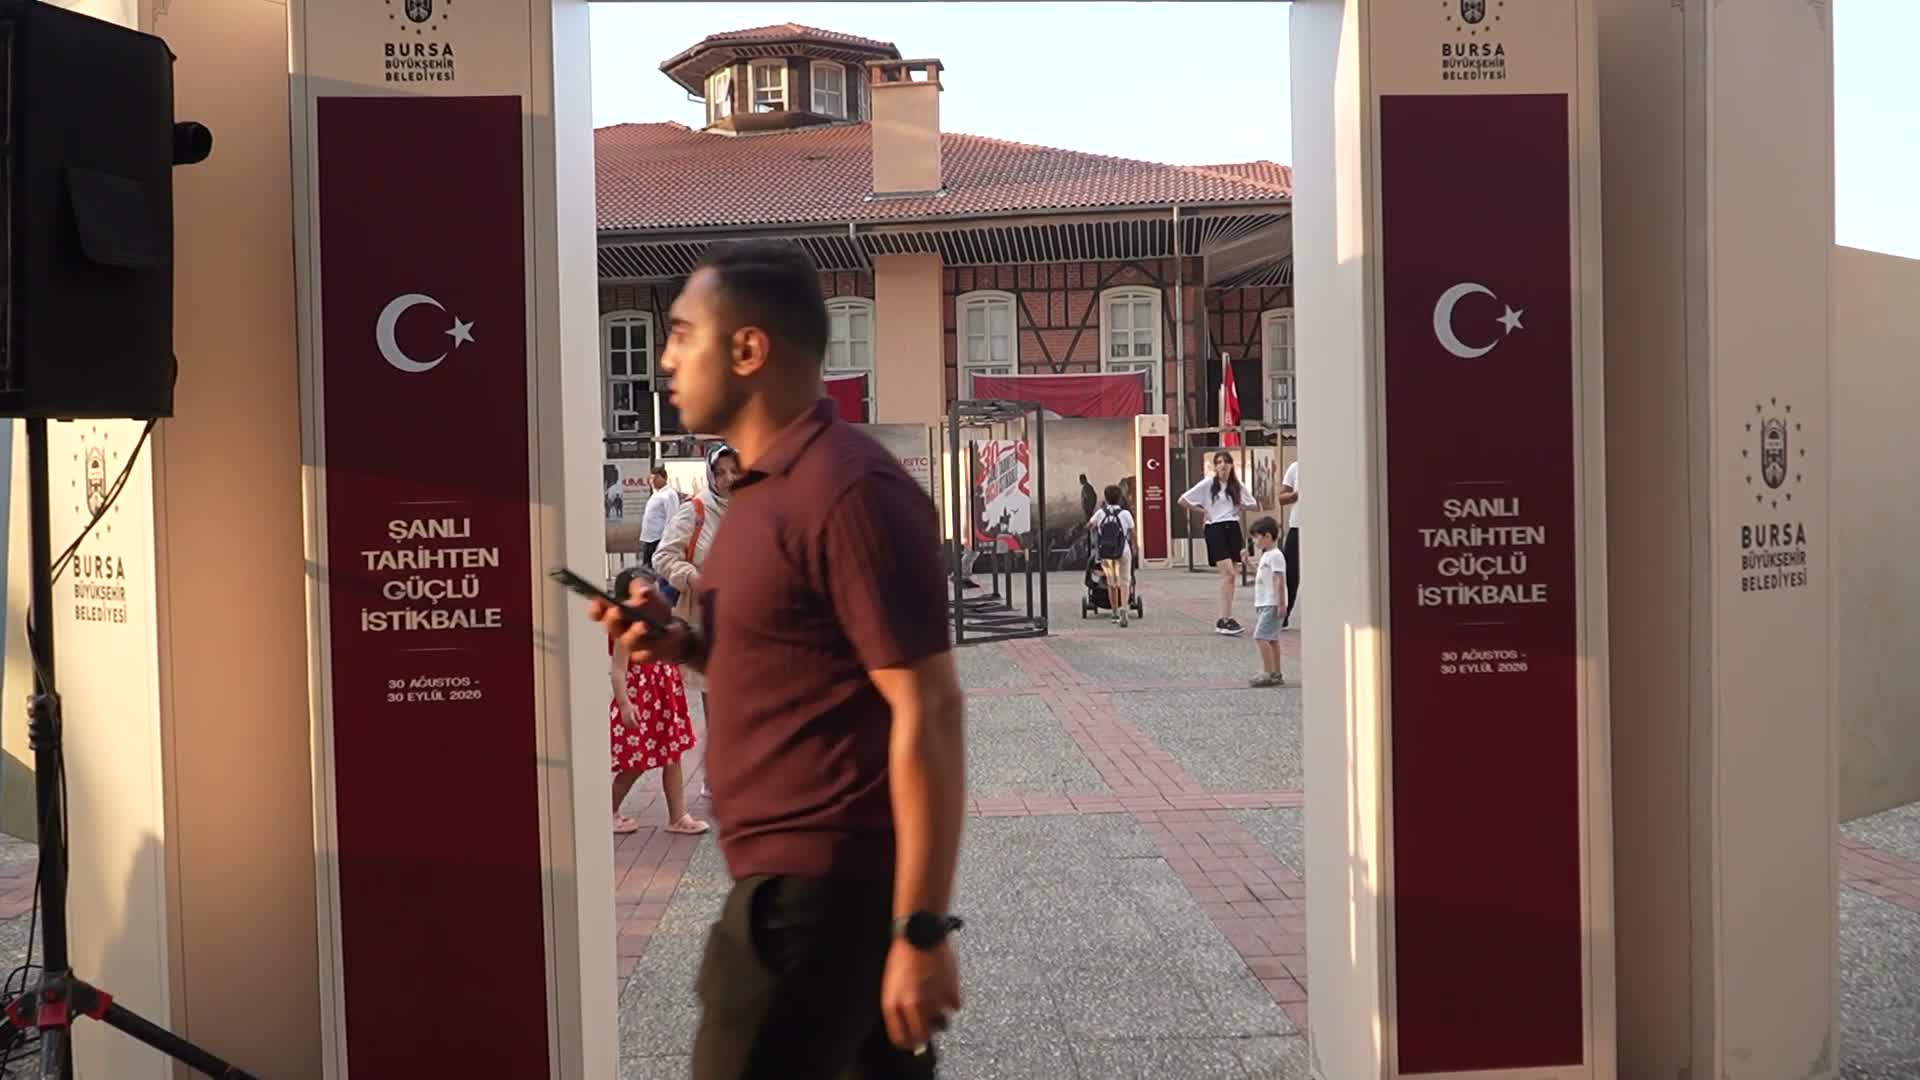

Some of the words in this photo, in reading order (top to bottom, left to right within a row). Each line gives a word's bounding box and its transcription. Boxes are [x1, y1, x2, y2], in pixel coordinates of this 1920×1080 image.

[384, 43, 454, 57] BURSA
[1442, 43, 1505, 57] BURSA
[384, 57, 454, 70] BÜYÜKŞEHİR
[1442, 68, 1506, 81] BELEDİYESİ
[385, 69, 455, 82] BELEDİYESİ
[1443, 497, 1519, 521] ŞANLI
[388, 518, 471, 543] ŞANLI
[1418, 524, 1545, 548] TARİHTEN
[1741, 522, 1807, 550] BURSA
[73, 555, 126, 580] BURSA
[361, 545, 499, 571] TARİHTEN
[1438, 551, 1527, 580] GÜÇLÜ
[382, 574, 480, 604] GÜÇLÜ
[1741, 568, 1808, 592] BELEDİYESİ
[1417, 583, 1547, 606] İSTİKBALE
[74, 602, 127, 624] BELEDİYESİ
[361, 607, 502, 632] İSTİKBALE
[1441, 651, 1458, 662] 30
[1461, 648, 1518, 661] AĞUSTOS
[1440, 664, 1457, 674] 30
[1459, 662, 1494, 673] EYLÜL
[388, 679, 405, 689] 30
[408, 675, 471, 688] AĞUSTOS
[387, 692, 404, 702] 30
[407, 689, 445, 701] EYLÜL
[449, 689, 482, 701] 2026
